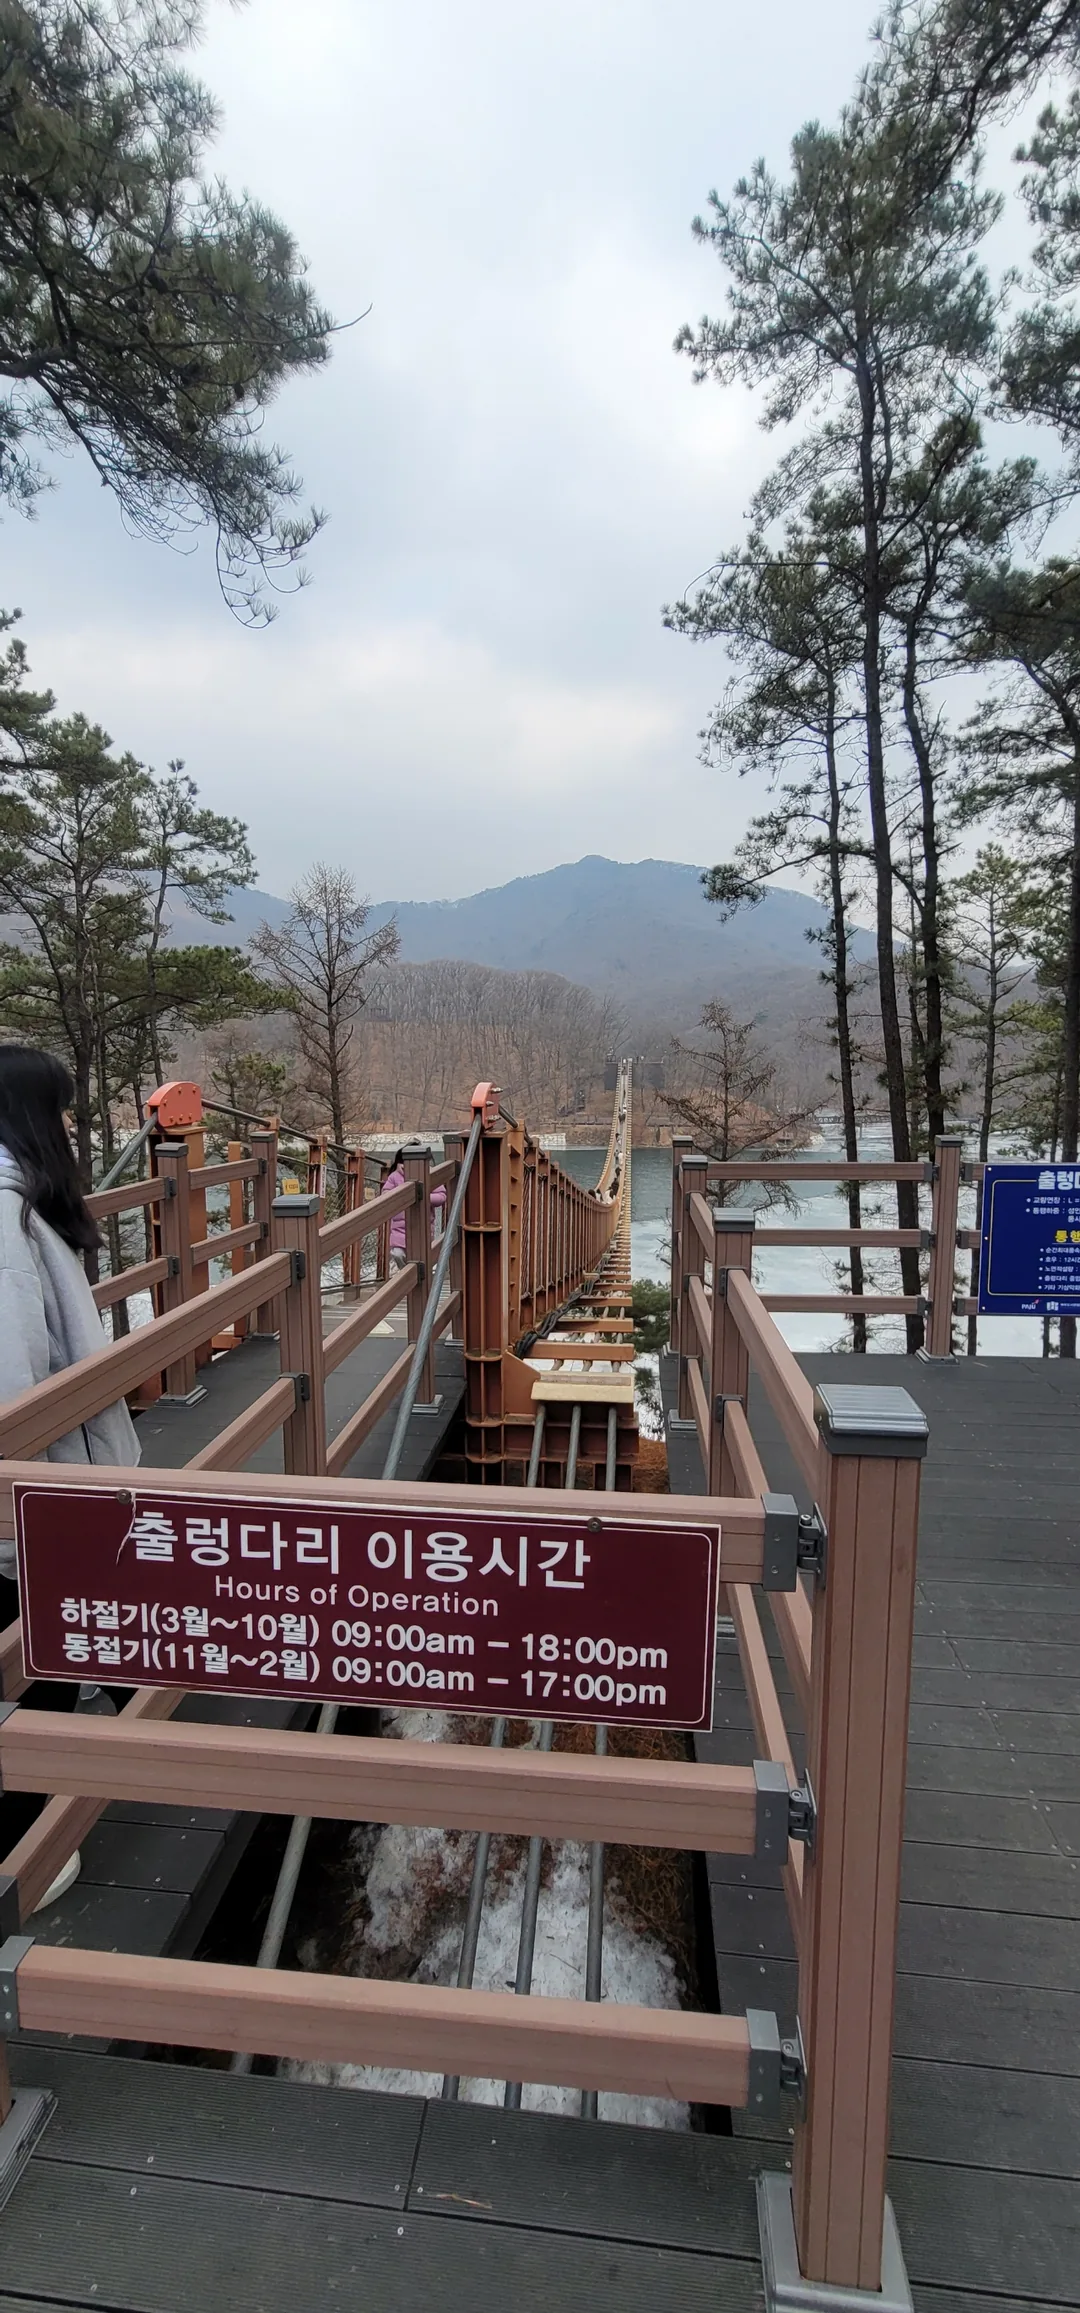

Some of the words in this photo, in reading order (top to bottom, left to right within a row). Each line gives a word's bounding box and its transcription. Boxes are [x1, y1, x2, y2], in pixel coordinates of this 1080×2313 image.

[129, 1511, 339, 1575] 출렁다리
[366, 1529, 591, 1590] 이용시간
[215, 1575, 300, 1603] Hours
[310, 1583, 338, 1606] of
[348, 1584, 499, 1617] Operation
[60, 1597, 320, 1648] 하절기(3월~10월)
[331, 1619, 475, 1655] 09:00am
[521, 1633, 668, 1669] 18:00pm
[62, 1632, 321, 1683] 동절기(11월~2월)
[331, 1655, 475, 1691] 09:00am
[520, 1669, 667, 1706] 17:00pm
